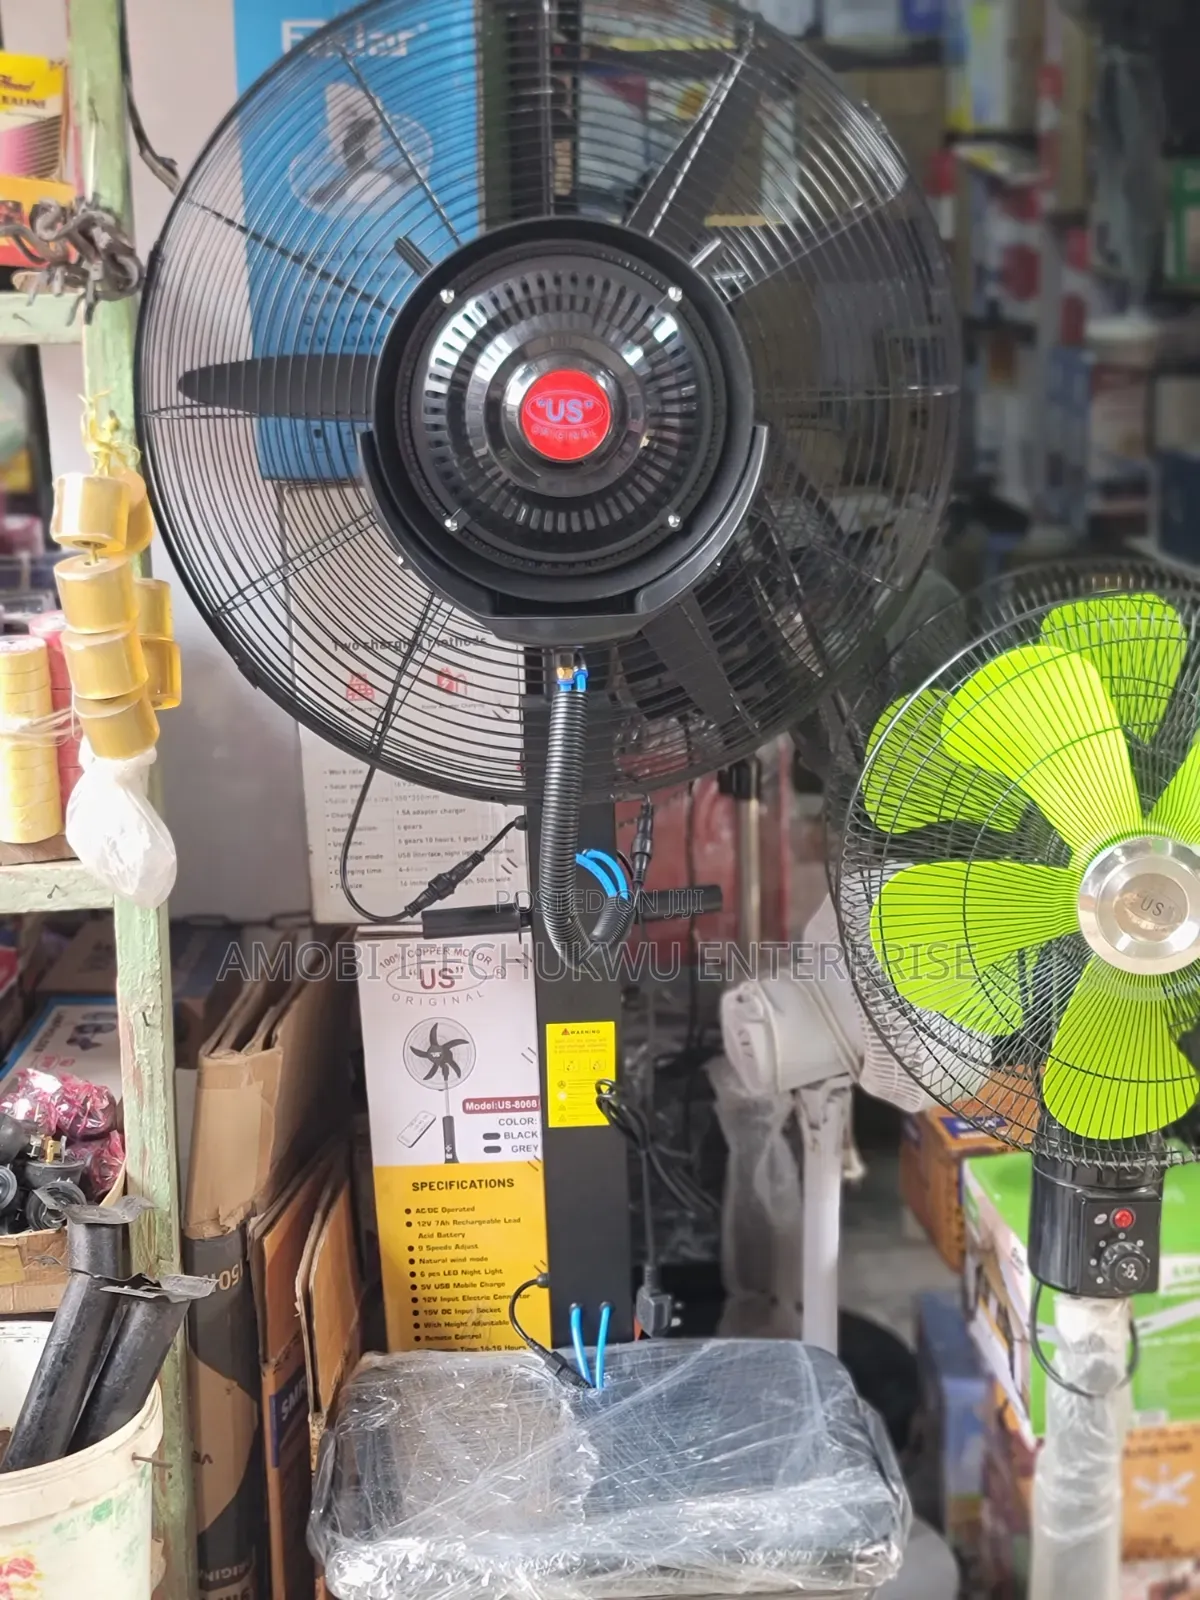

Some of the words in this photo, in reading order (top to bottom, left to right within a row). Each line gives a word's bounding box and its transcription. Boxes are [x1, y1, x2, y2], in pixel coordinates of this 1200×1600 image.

[440, 807, 466, 817] charger
[397, 851, 412, 859] USB
[476, 876, 495, 884] 50cm
[379, 952, 405, 970] 100%
[406, 946, 451, 959] COPPER
[453, 947, 493, 966] MOTOR
[391, 990, 484, 1007] ORIGINAL
[498, 1117, 538, 1127] COLOR:
[503, 1131, 539, 1140] BLACK
[511, 1144, 539, 1153] GREY
[411, 1178, 516, 1192] SPECIFICATIONS
[441, 1205, 476, 1215] Operated
[452, 1218, 502, 1227] Rechargeable
[418, 1232, 434, 1240] Acid
[436, 1231, 466, 1240] Battery
[425, 1244, 453, 1254] Speeds
[454, 1243, 479, 1252] Adjust
[418, 1257, 448, 1265] Natural
[449, 1256, 467, 1264] wind
[460, 1269, 482, 1278] Night
[484, 1268, 503, 1276] Light
[479, 1281, 506, 1289] Charge
[440, 1296, 460, 1304] Input
[461, 1294, 491, 1302] Electric
[492, 1293, 531, 1301] Conntor
[475, 1307, 502, 1315] Socket
[423, 1321, 442, 1329] With
[444, 1320, 469, 1330] Height
[454, 1333, 482, 1341] Control
